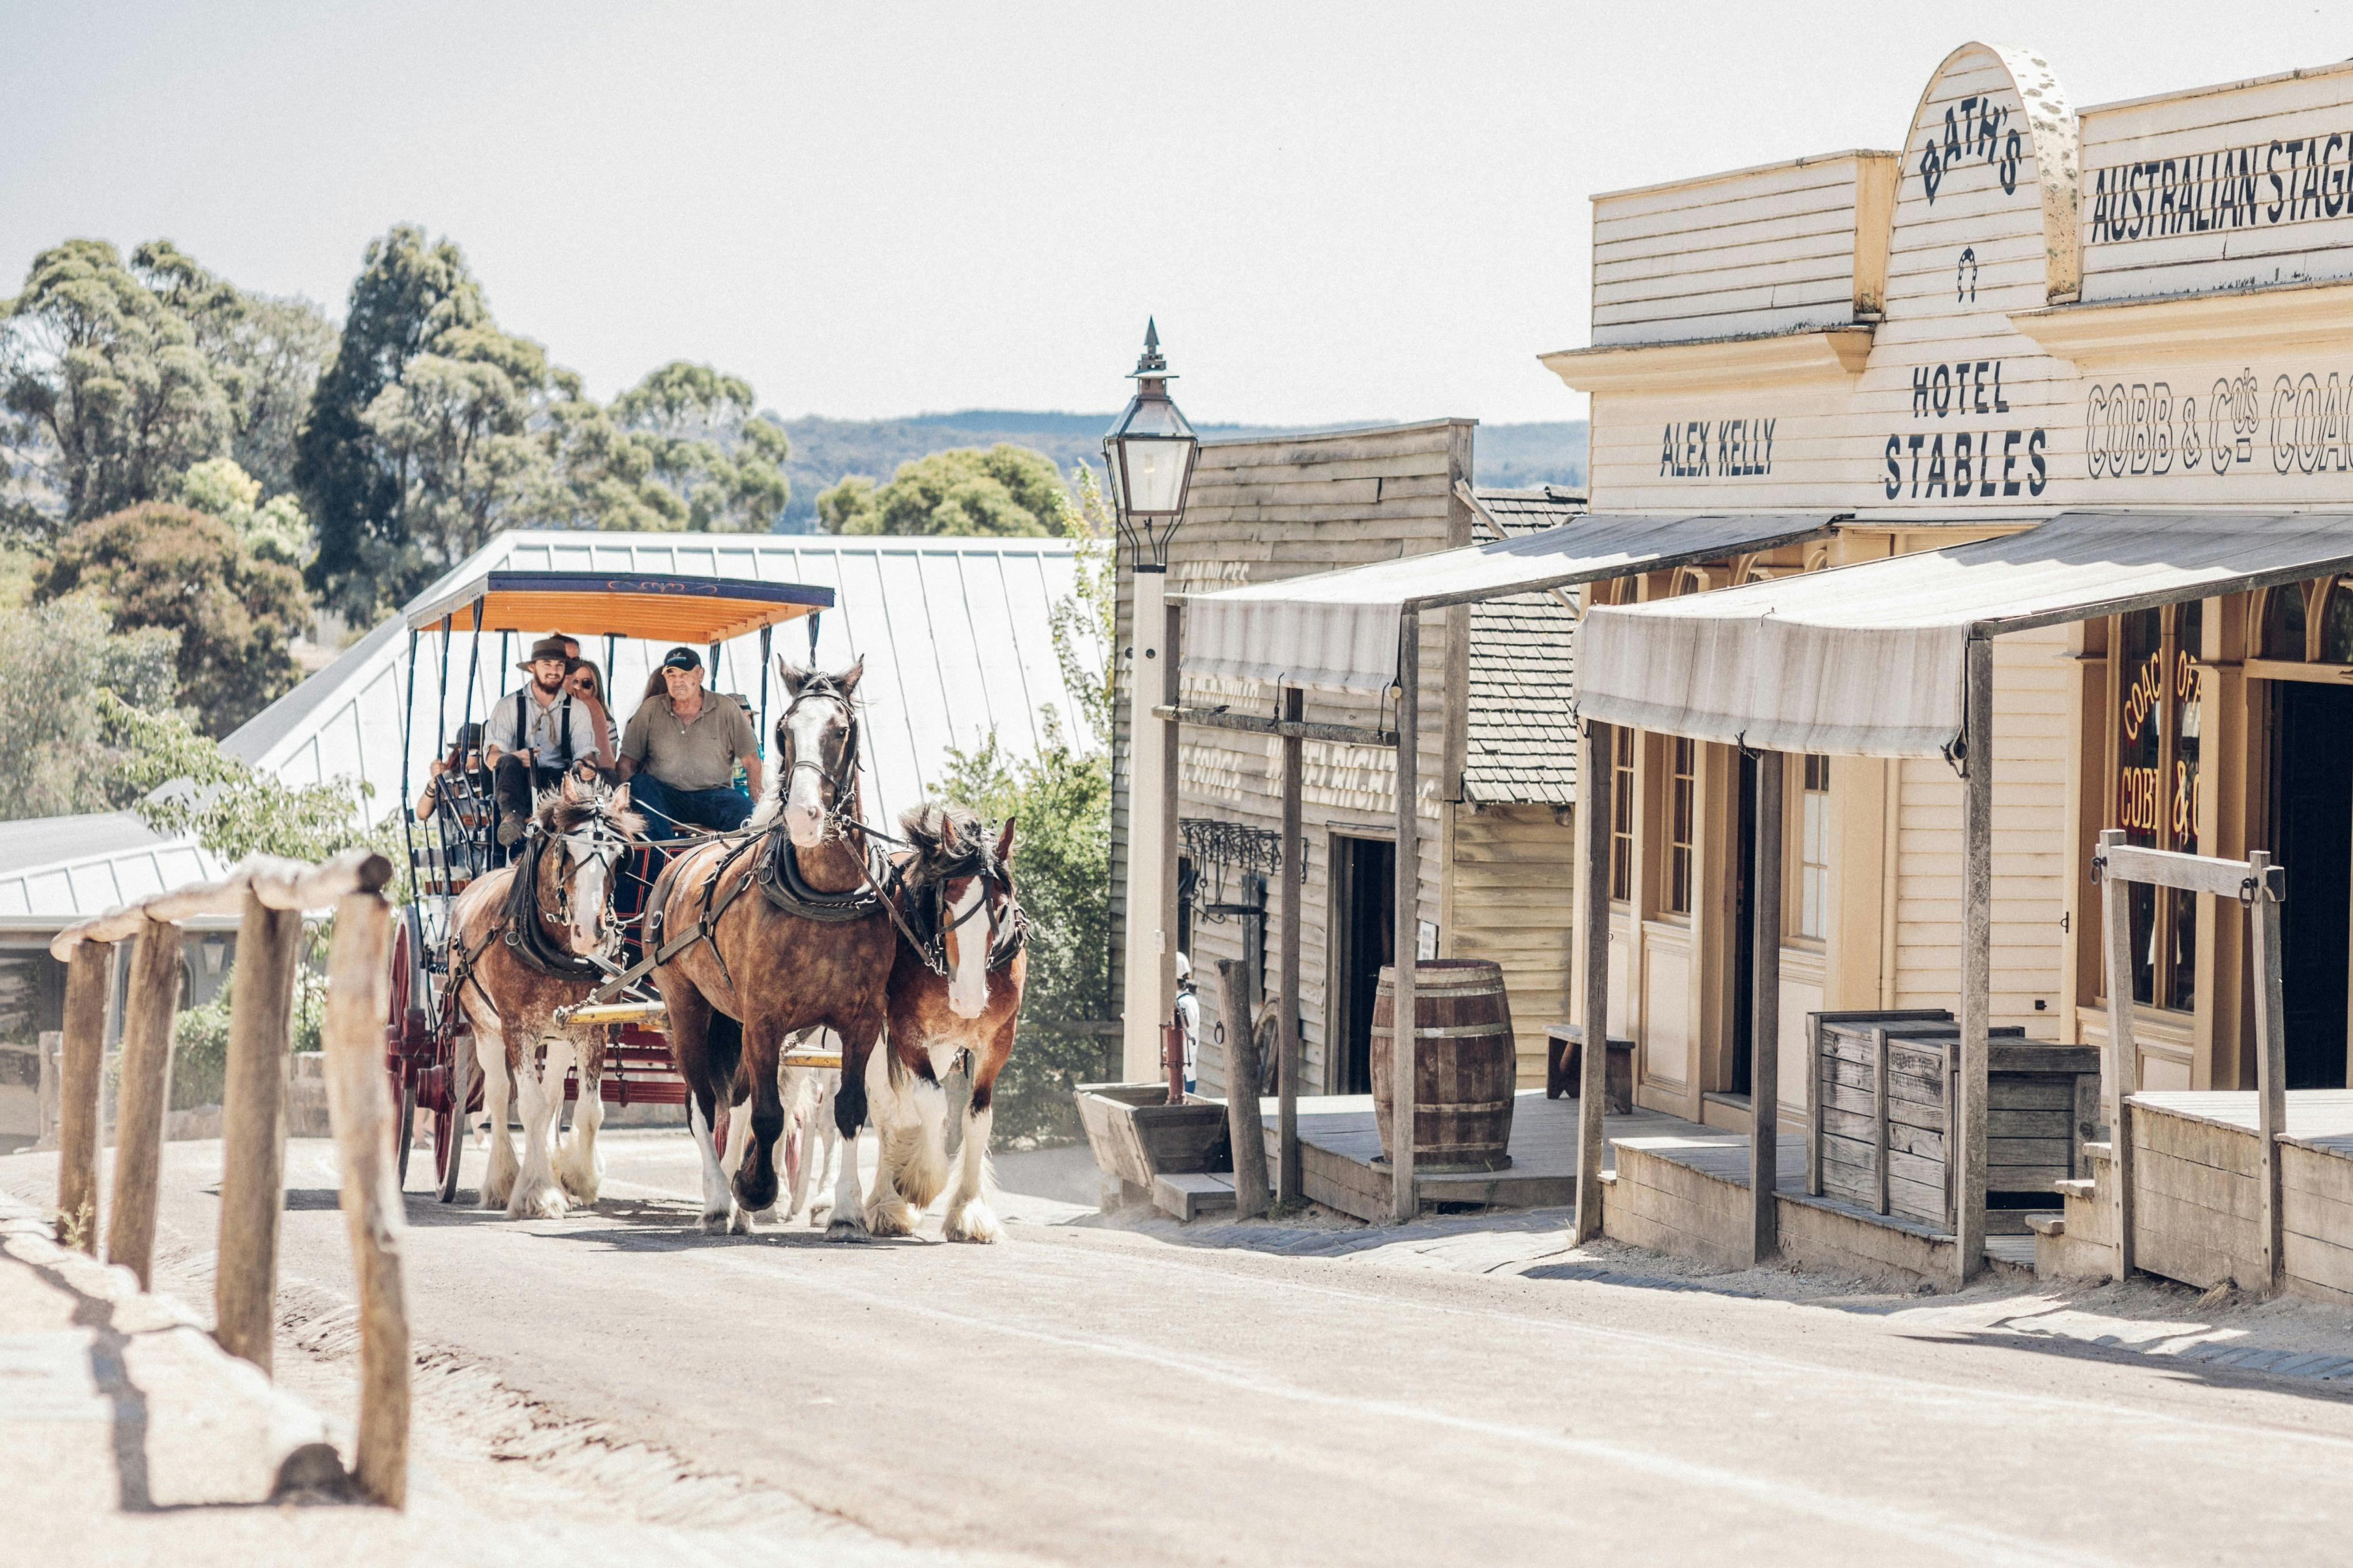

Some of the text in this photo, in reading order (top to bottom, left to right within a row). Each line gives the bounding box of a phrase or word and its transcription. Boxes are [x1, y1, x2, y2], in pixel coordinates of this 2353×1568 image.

[2092, 132, 2353, 243] AUSTRALIAN STAG
[1913, 361, 2009, 418] HOTEL
[1660, 418, 1776, 477] ALEX KELLY
[1885, 427, 2047, 500] STABLES
[2086, 382, 2174, 479] COBB
[2181, 397, 2202, 469] &
[2173, 760, 2189, 845] &
